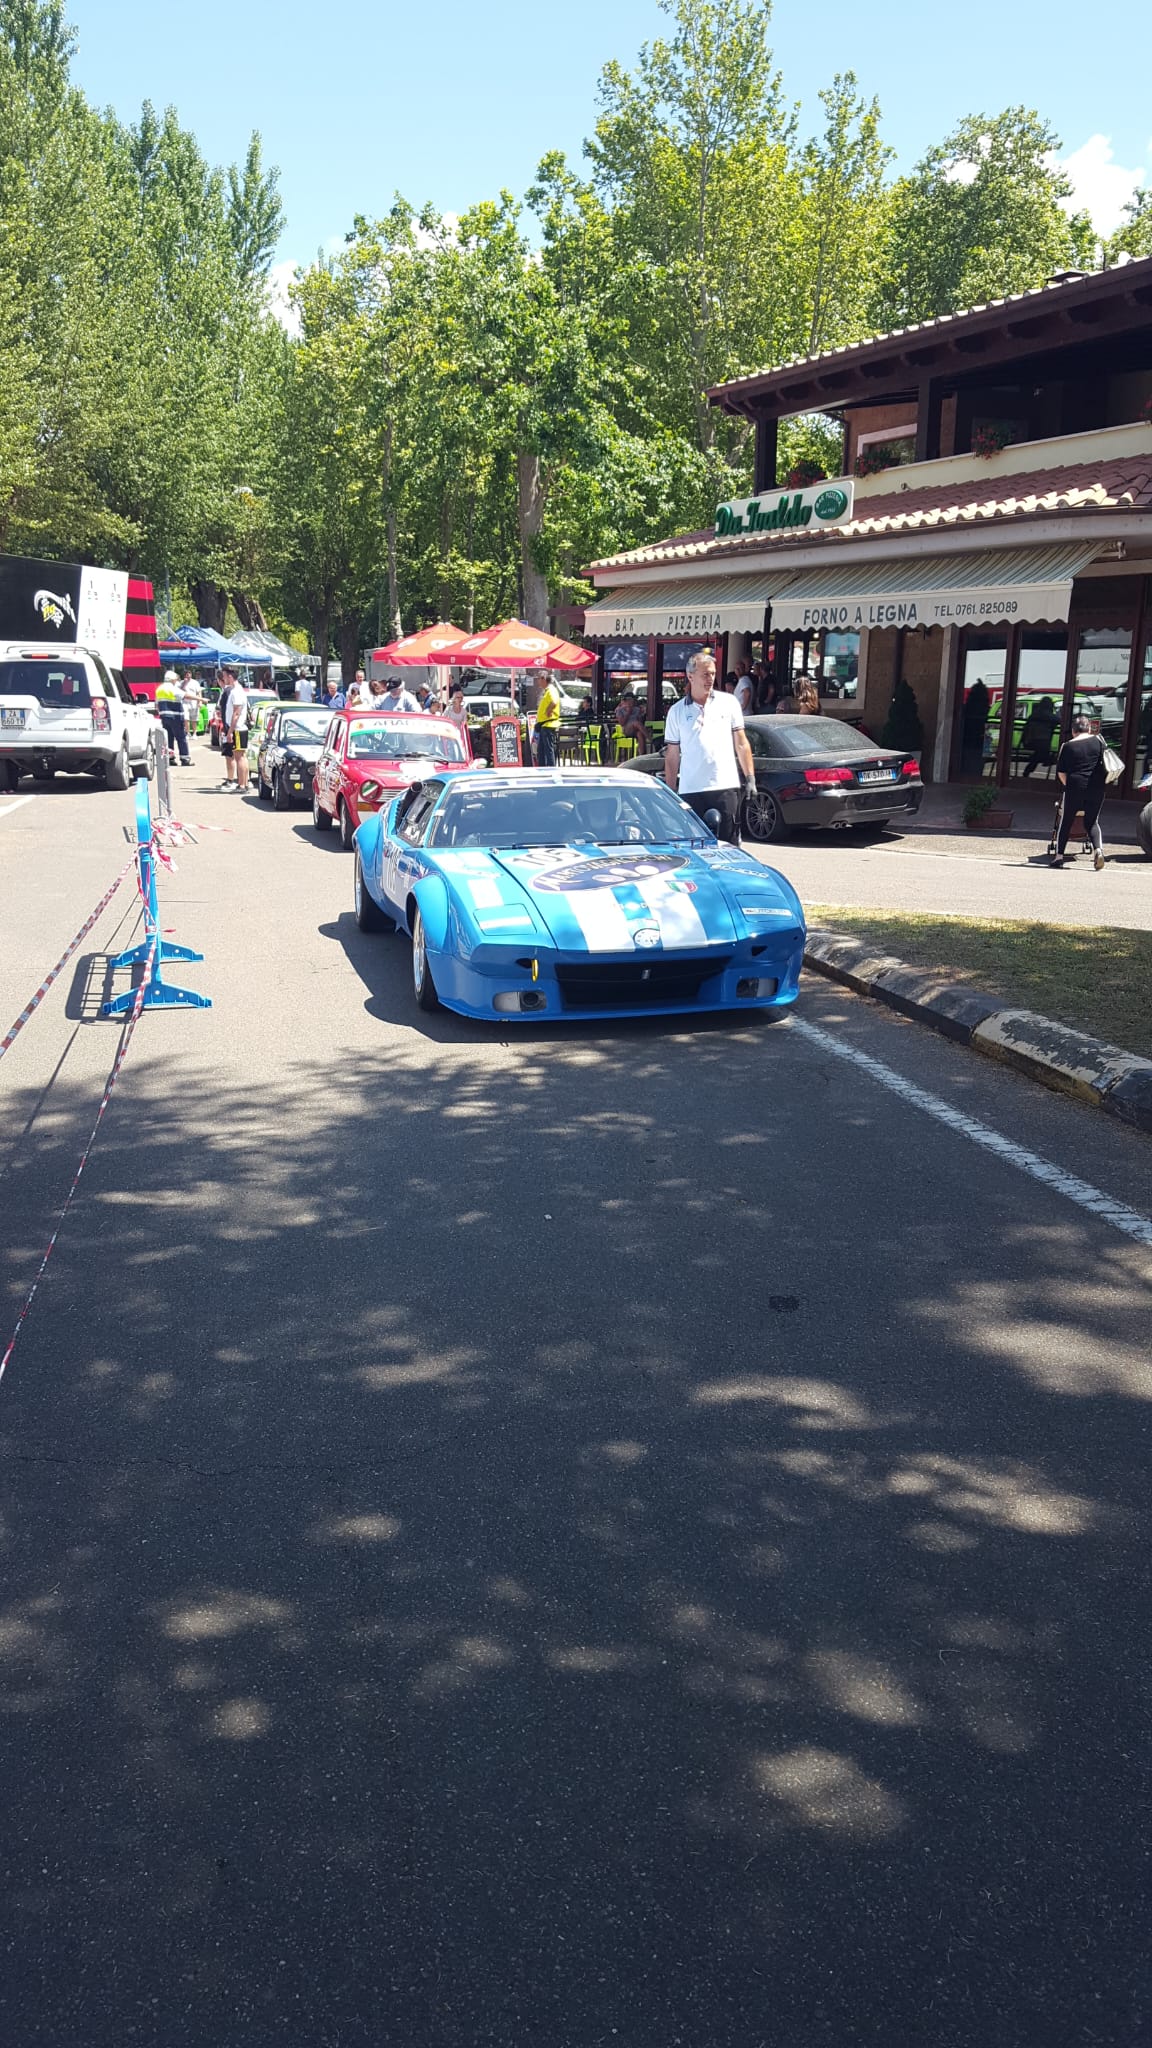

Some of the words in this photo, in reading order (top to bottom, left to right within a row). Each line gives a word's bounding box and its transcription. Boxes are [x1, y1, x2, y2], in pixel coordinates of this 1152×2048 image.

[714, 505, 743, 537] Da
[615, 618, 635, 632] BAR
[667, 614, 721, 630] PIZZERIA
[803, 606, 848, 626] FORNO
[855, 606, 863, 624] A
[869, 603, 918, 623] LEGNA
[512, 849, 582, 866] 105
